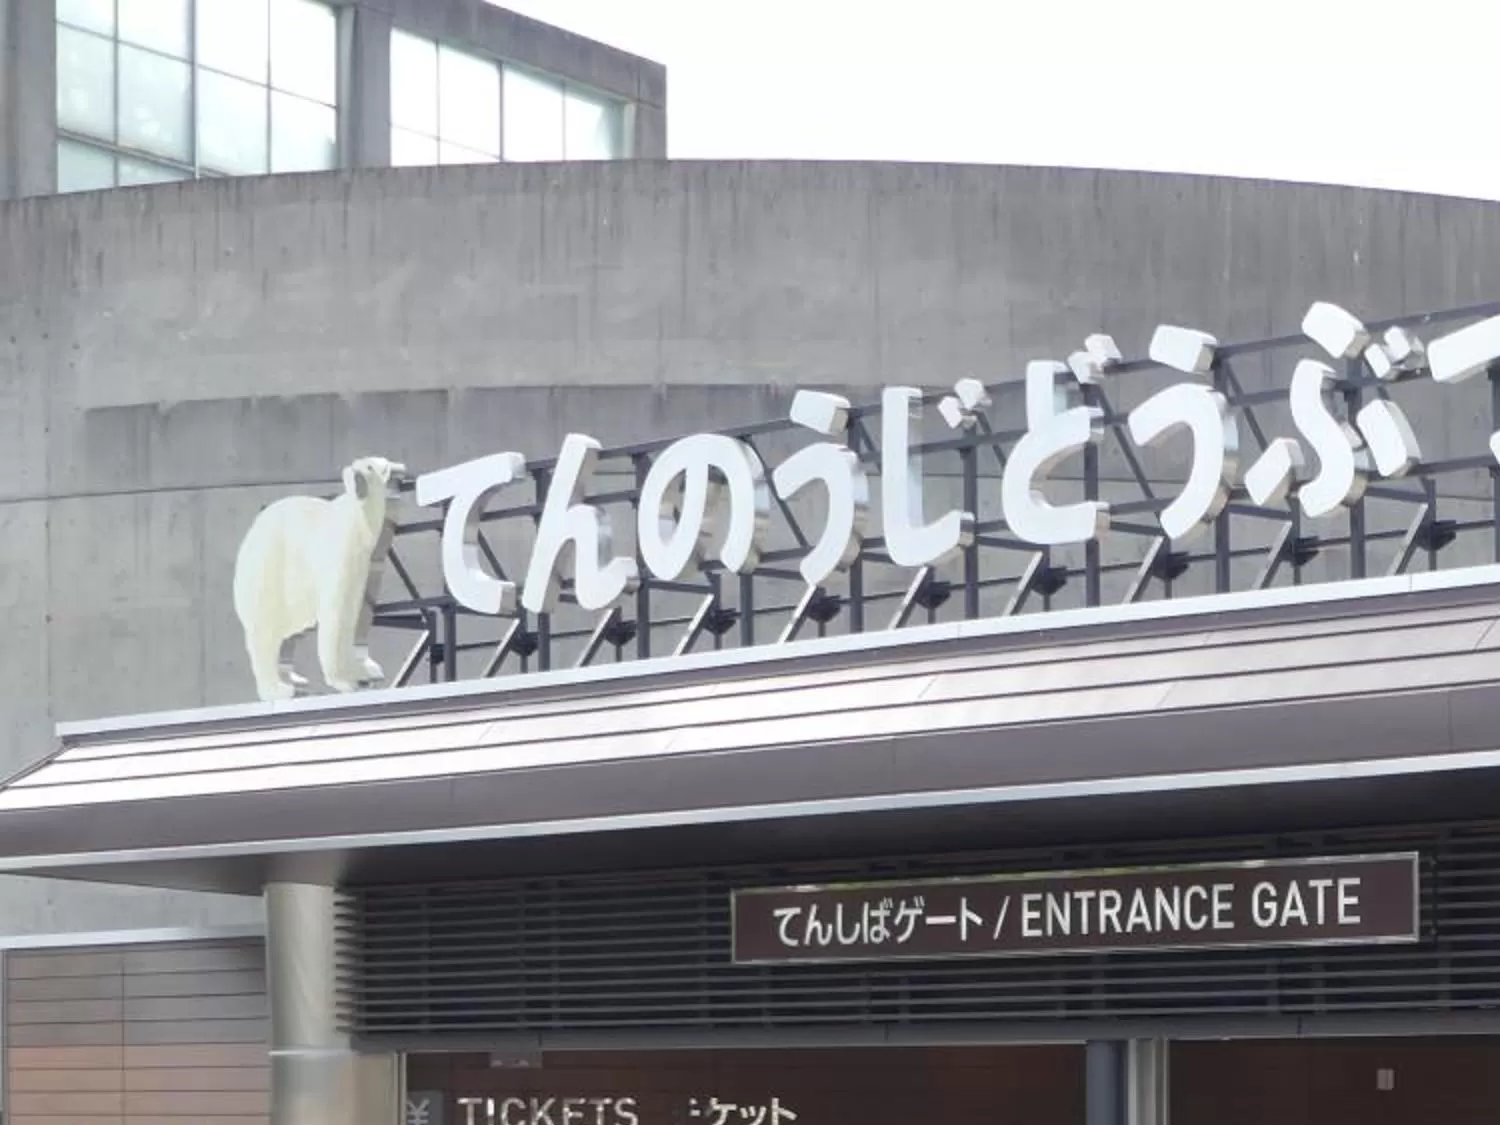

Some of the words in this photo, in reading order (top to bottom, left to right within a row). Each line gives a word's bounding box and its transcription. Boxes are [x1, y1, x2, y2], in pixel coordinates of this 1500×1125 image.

[773, 896, 983, 946] てんしばゲート
[1021, 883, 1235, 938] ENTRANCE
[1252, 877, 1361, 928] GATE
